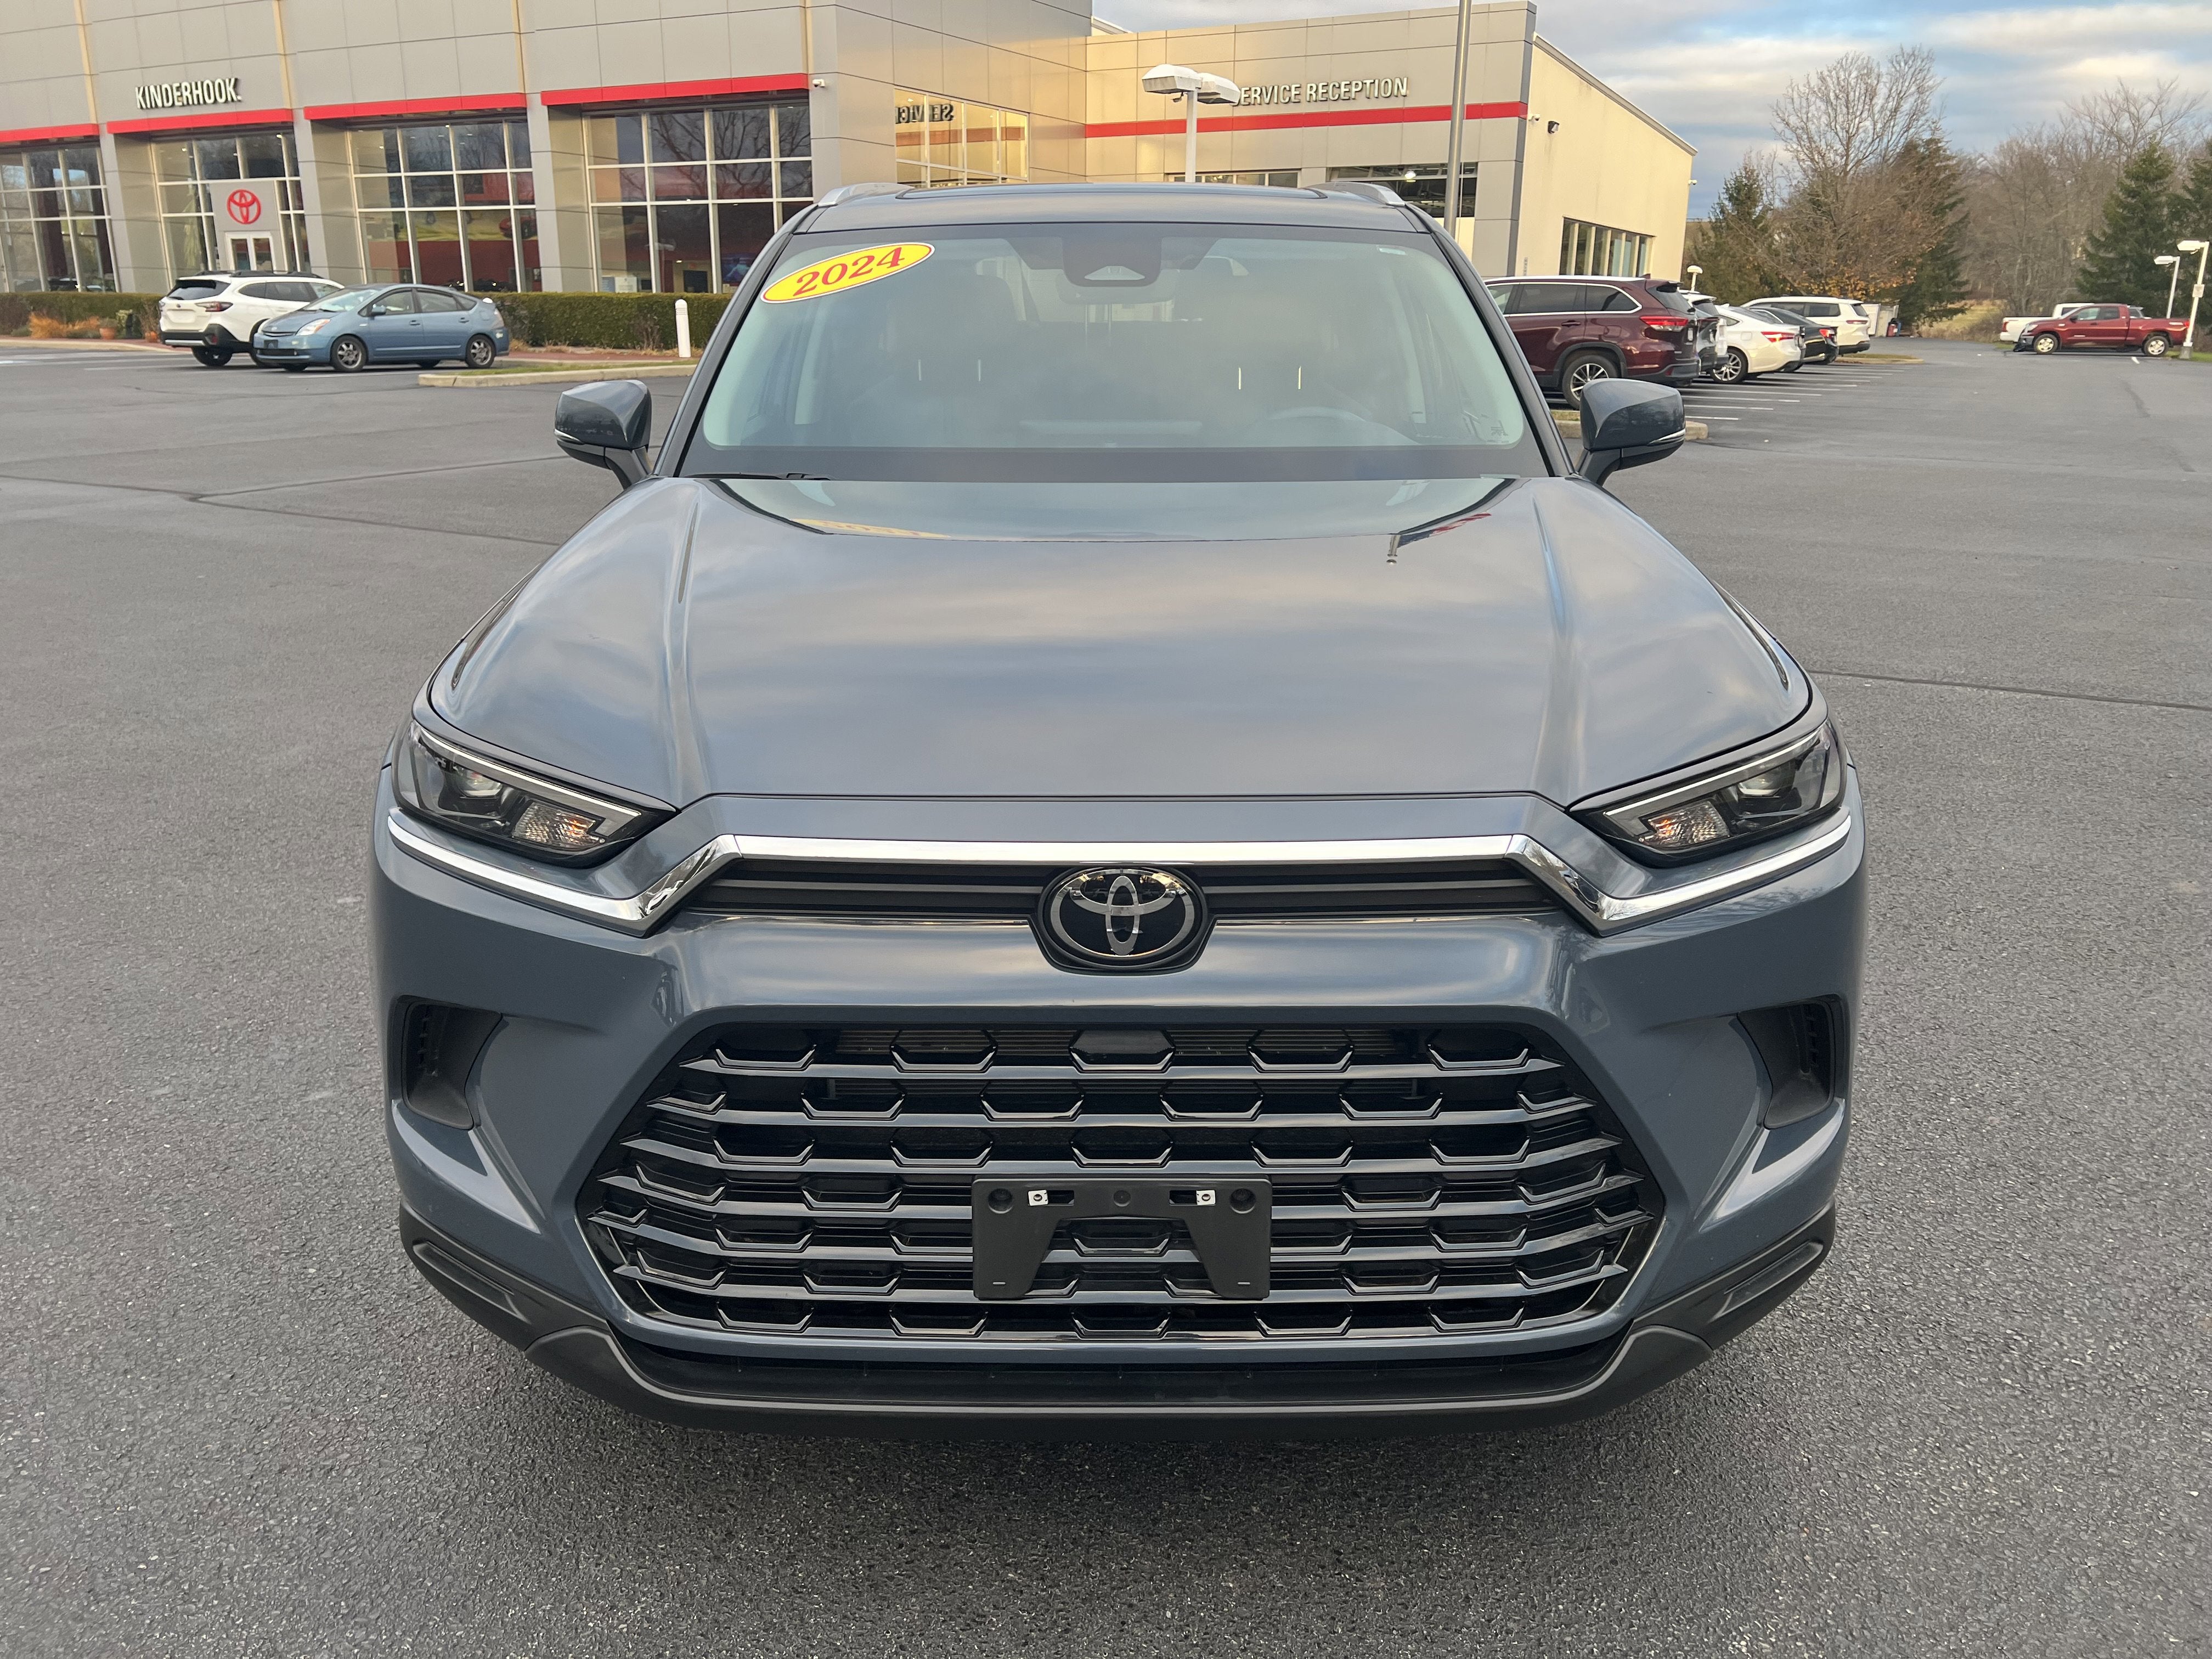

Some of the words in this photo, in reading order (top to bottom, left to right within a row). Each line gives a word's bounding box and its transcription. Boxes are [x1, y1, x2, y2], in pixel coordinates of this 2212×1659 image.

[136, 78, 238, 109] KINDERHOOK
[1229, 84, 1301, 106] ERVICE
[1306, 77, 1408, 103] RECEPTION
[793, 247, 905, 297] 2024
